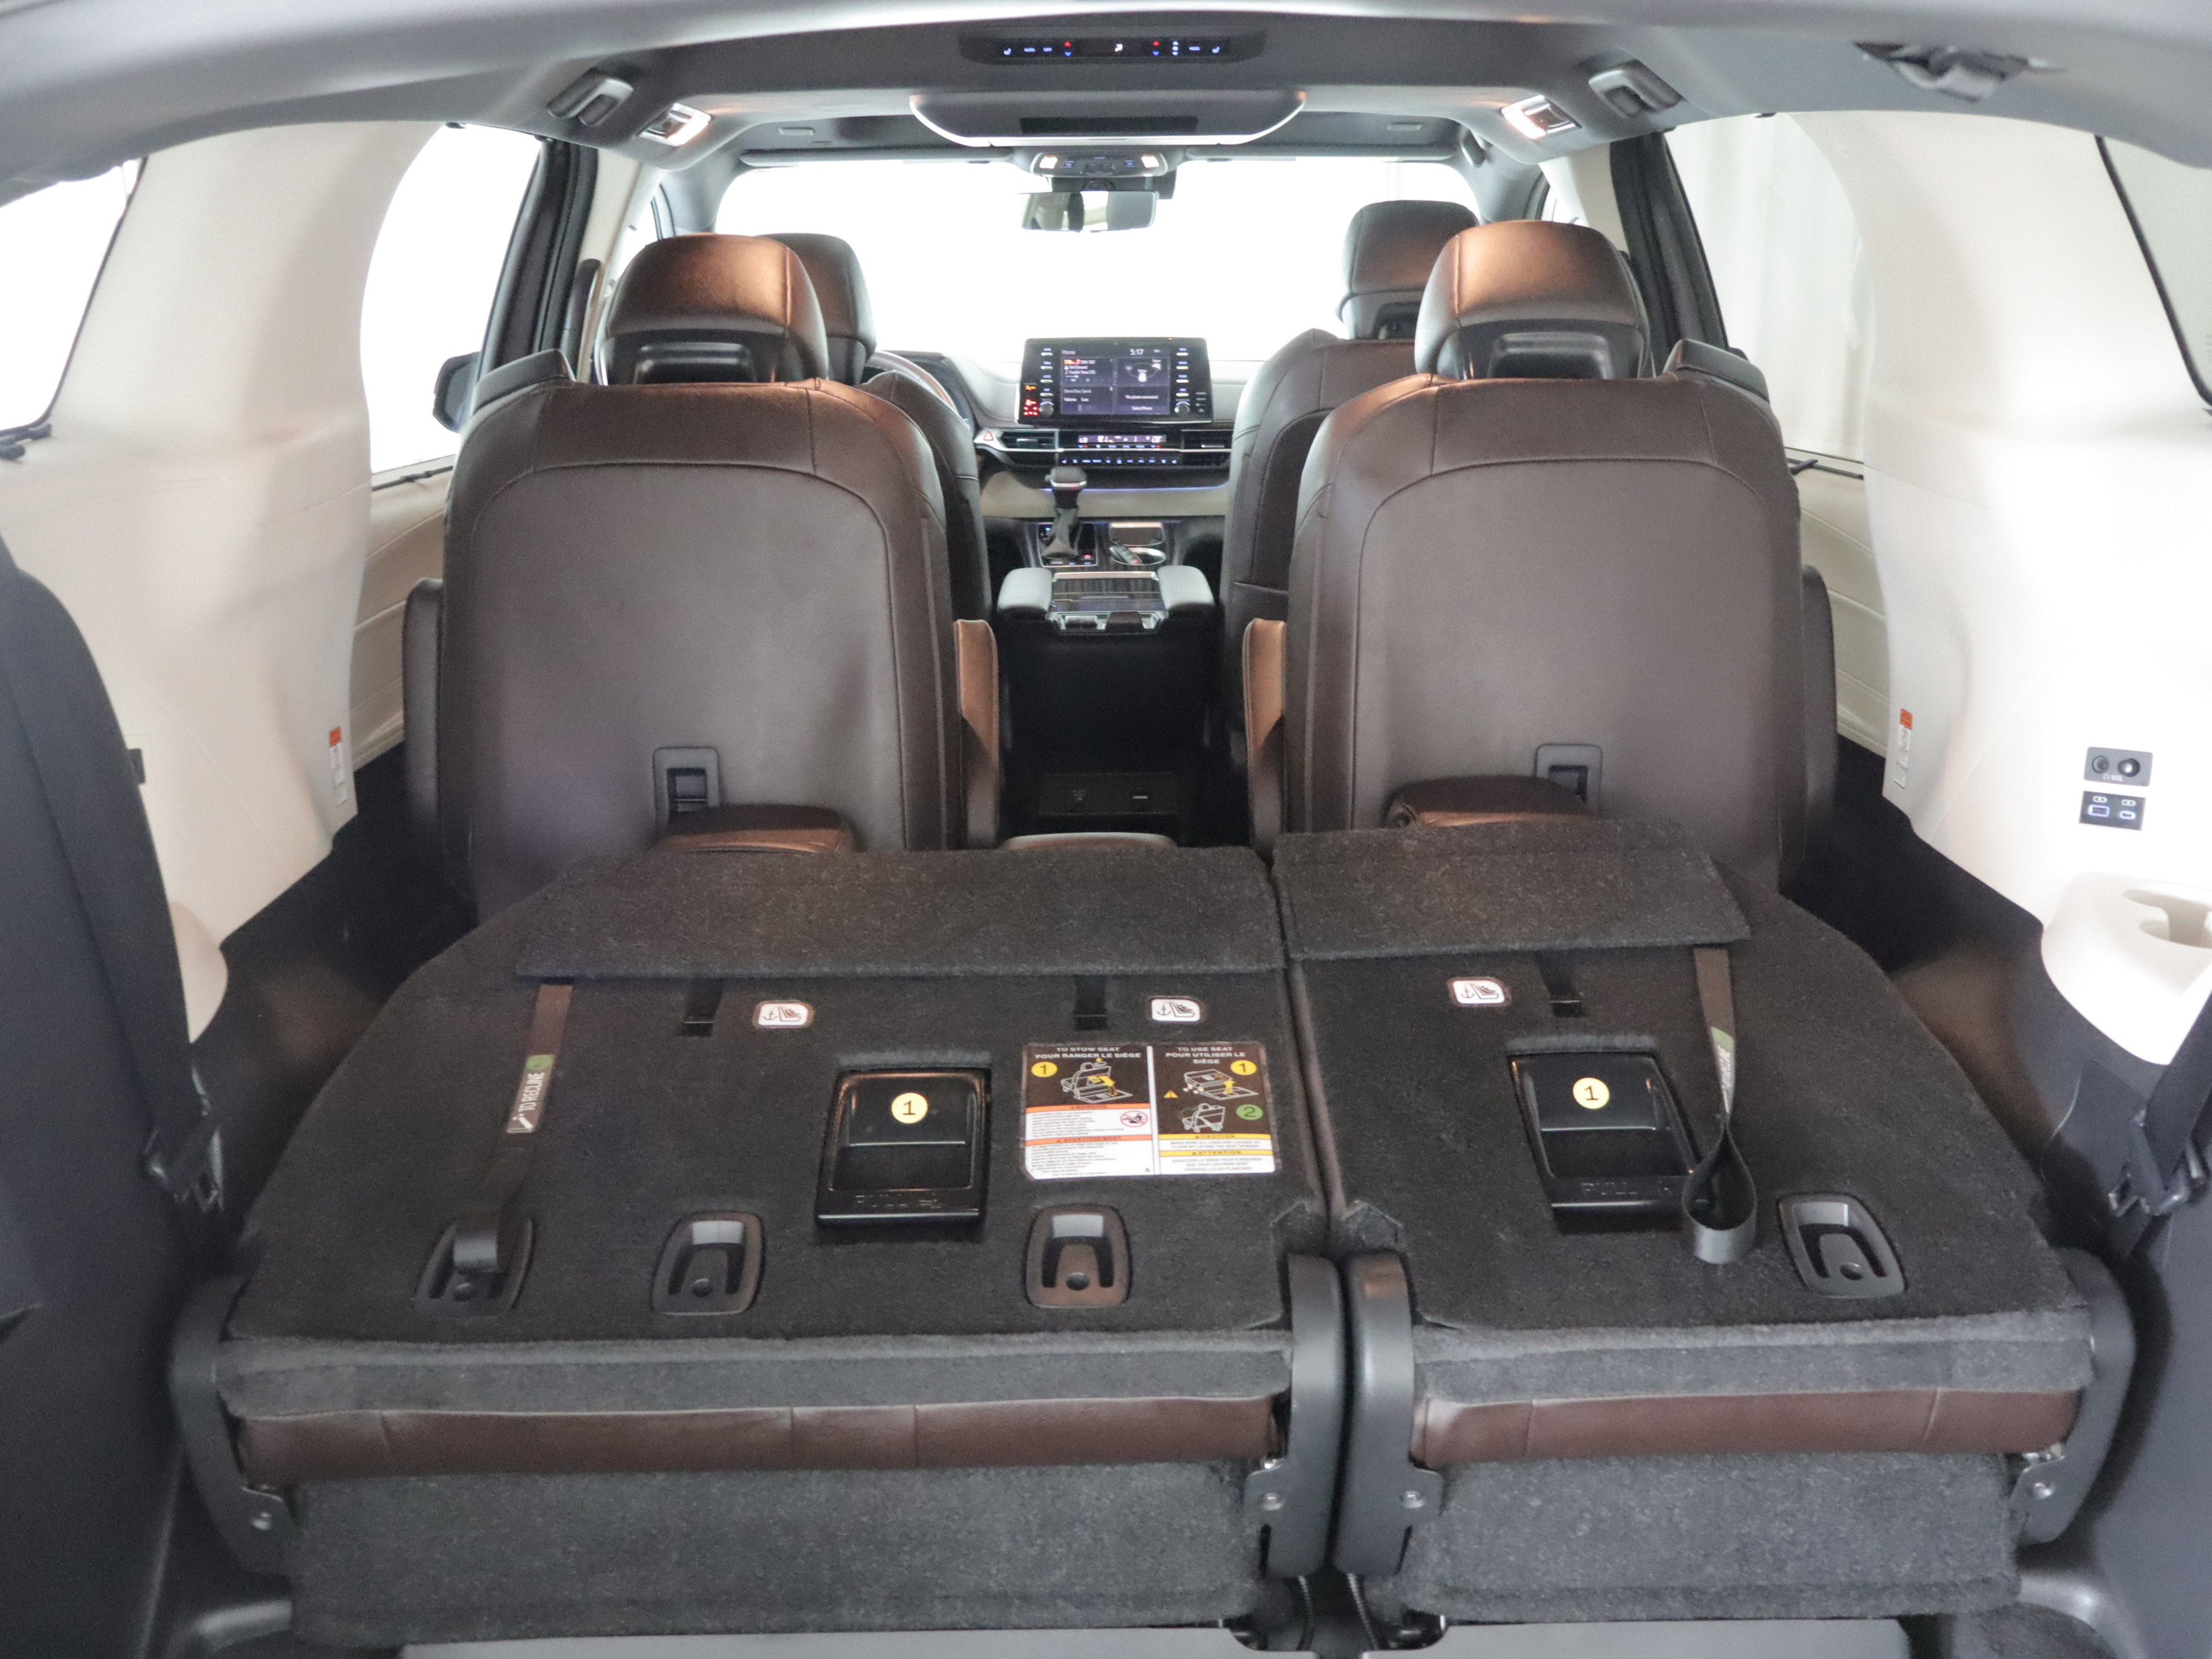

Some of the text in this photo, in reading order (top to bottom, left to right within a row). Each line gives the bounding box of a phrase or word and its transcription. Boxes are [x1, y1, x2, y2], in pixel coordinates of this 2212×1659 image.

[1039, 1064, 1047, 1075] 1
[1239, 1062, 1246, 1073] 1
[518, 1072, 545, 1112] TO RECLINE
[1584, 1085, 1599, 1101] 1
[902, 1100, 916, 1116] 1
[1244, 1107, 1257, 1118] 2
